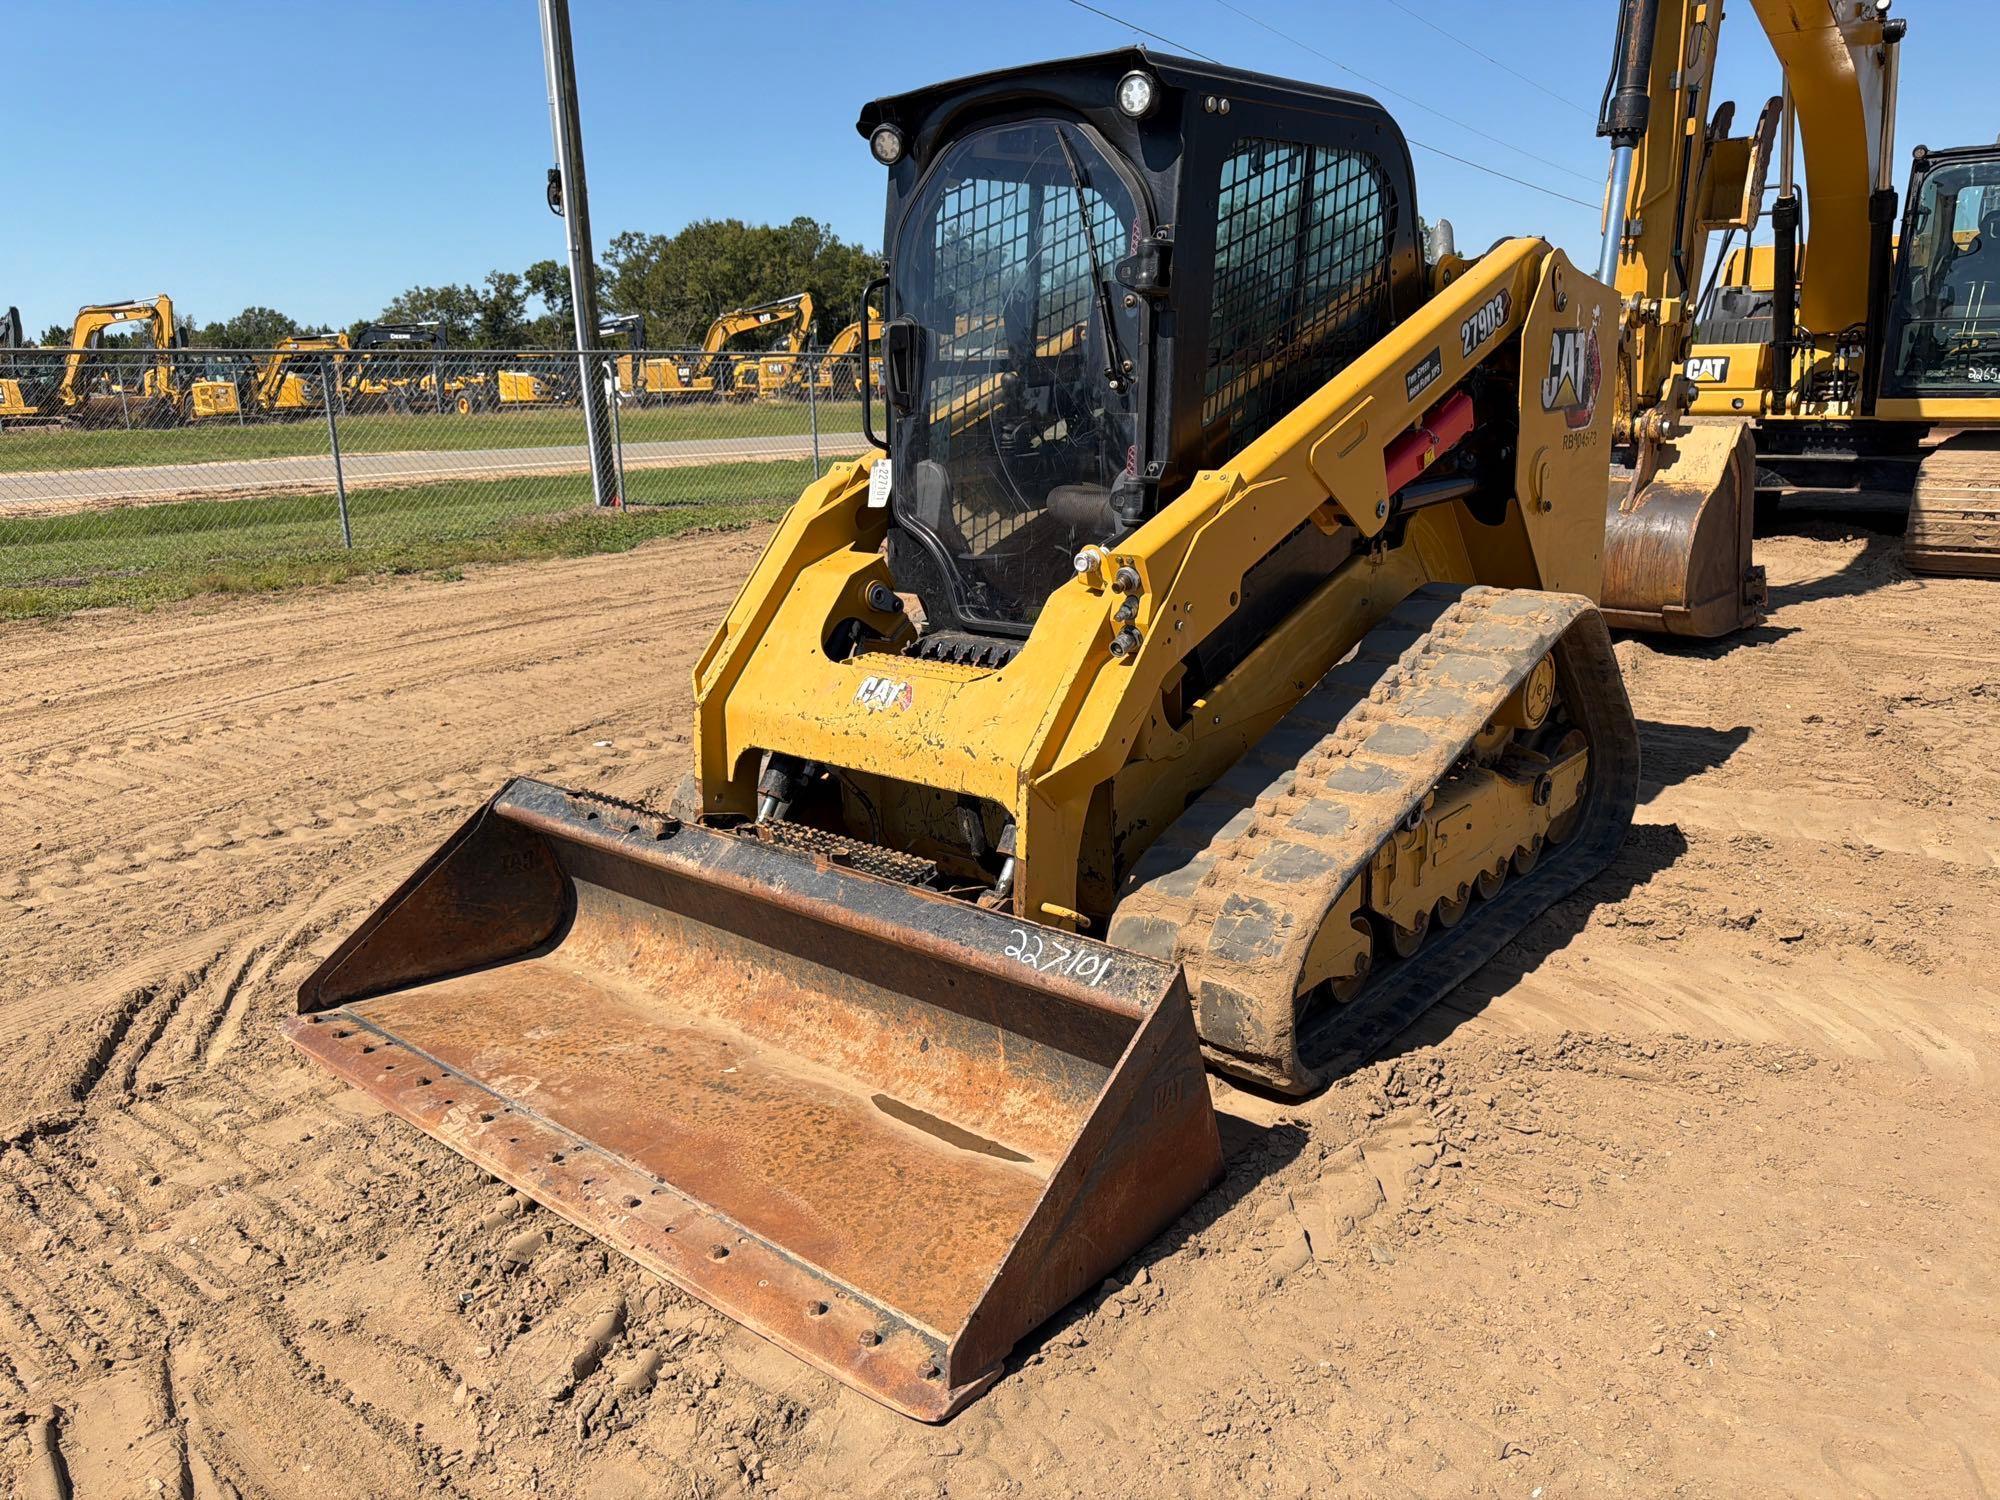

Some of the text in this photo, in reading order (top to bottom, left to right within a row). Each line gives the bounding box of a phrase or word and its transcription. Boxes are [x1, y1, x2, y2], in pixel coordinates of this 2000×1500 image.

[759, 313, 771, 323] CAT
[1461, 294, 1504, 356] 279D3
[768, 364, 783, 374] CAT
[1542, 331, 1586, 409] CAT
[1686, 358, 1726, 381] CAT
[1968, 366, 2000, 382] 2265
[876, 468, 889, 501] 227101
[854, 676, 908, 709] CAT
[1004, 928, 1114, 987] 227101
